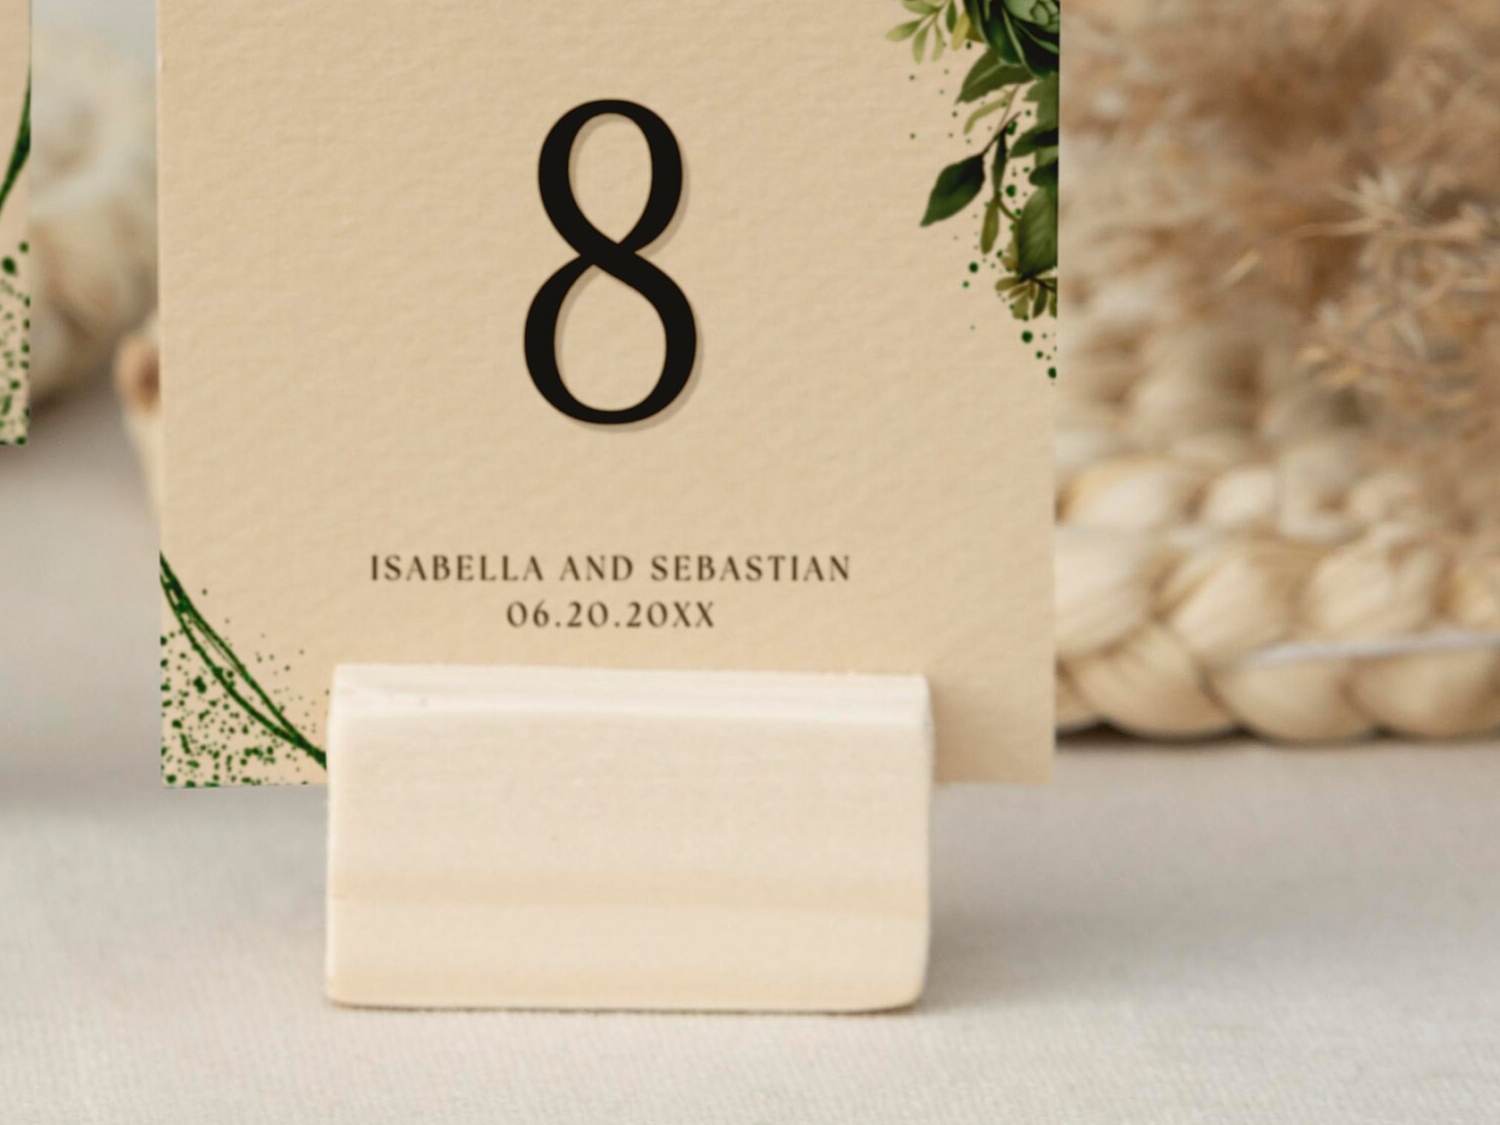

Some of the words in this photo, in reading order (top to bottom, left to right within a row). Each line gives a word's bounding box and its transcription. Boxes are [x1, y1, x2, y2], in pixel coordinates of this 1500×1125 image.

[522, 98, 698, 426] 8
[370, 554, 545, 582] ISABELLA
[558, 554, 635, 582] AND
[650, 554, 851, 583] SEBASTIAN
[506, 600, 716, 629] 06.20.20XX
